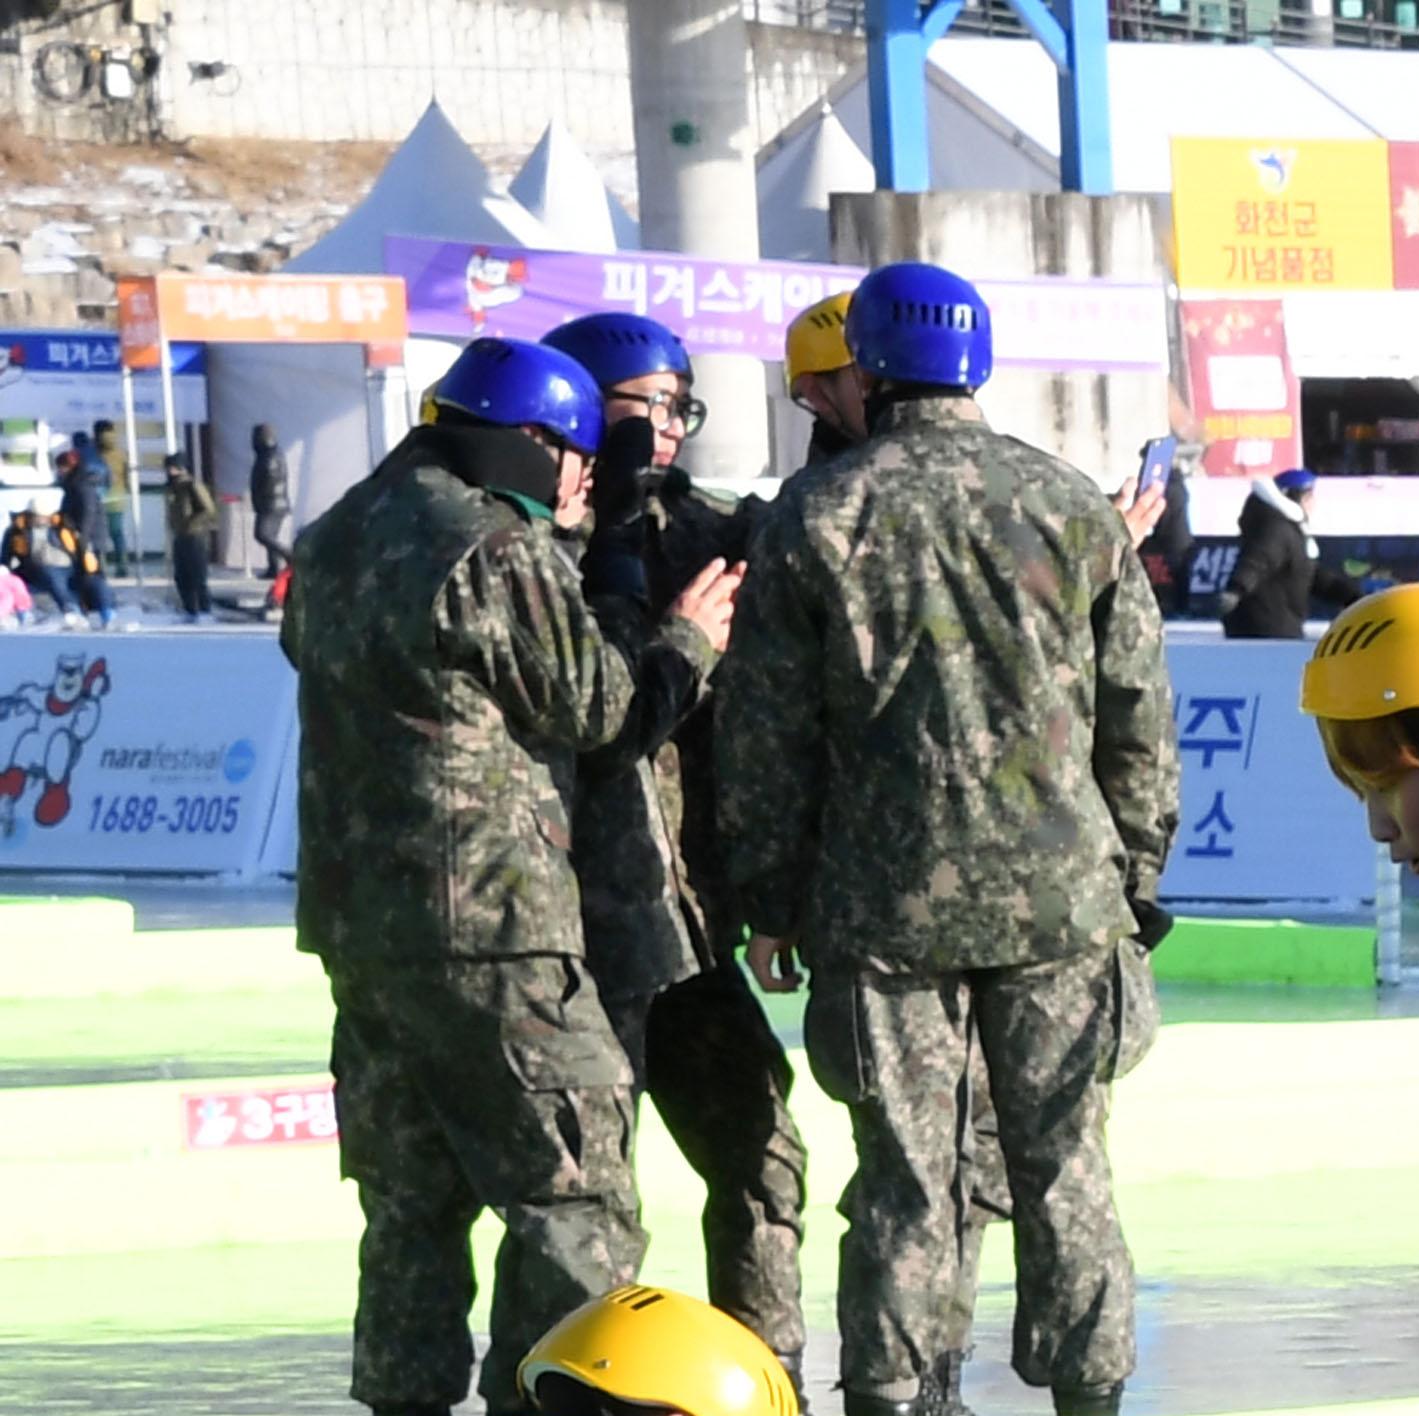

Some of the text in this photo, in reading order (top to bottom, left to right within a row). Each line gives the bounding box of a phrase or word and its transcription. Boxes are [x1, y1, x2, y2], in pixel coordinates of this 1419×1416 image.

[1234, 200, 1319, 239] 화천군
[1221, 245, 1336, 284] 기념품점
[47, 341, 121, 369] 피겨스
[88, 795, 240, 834] 1688-3005
